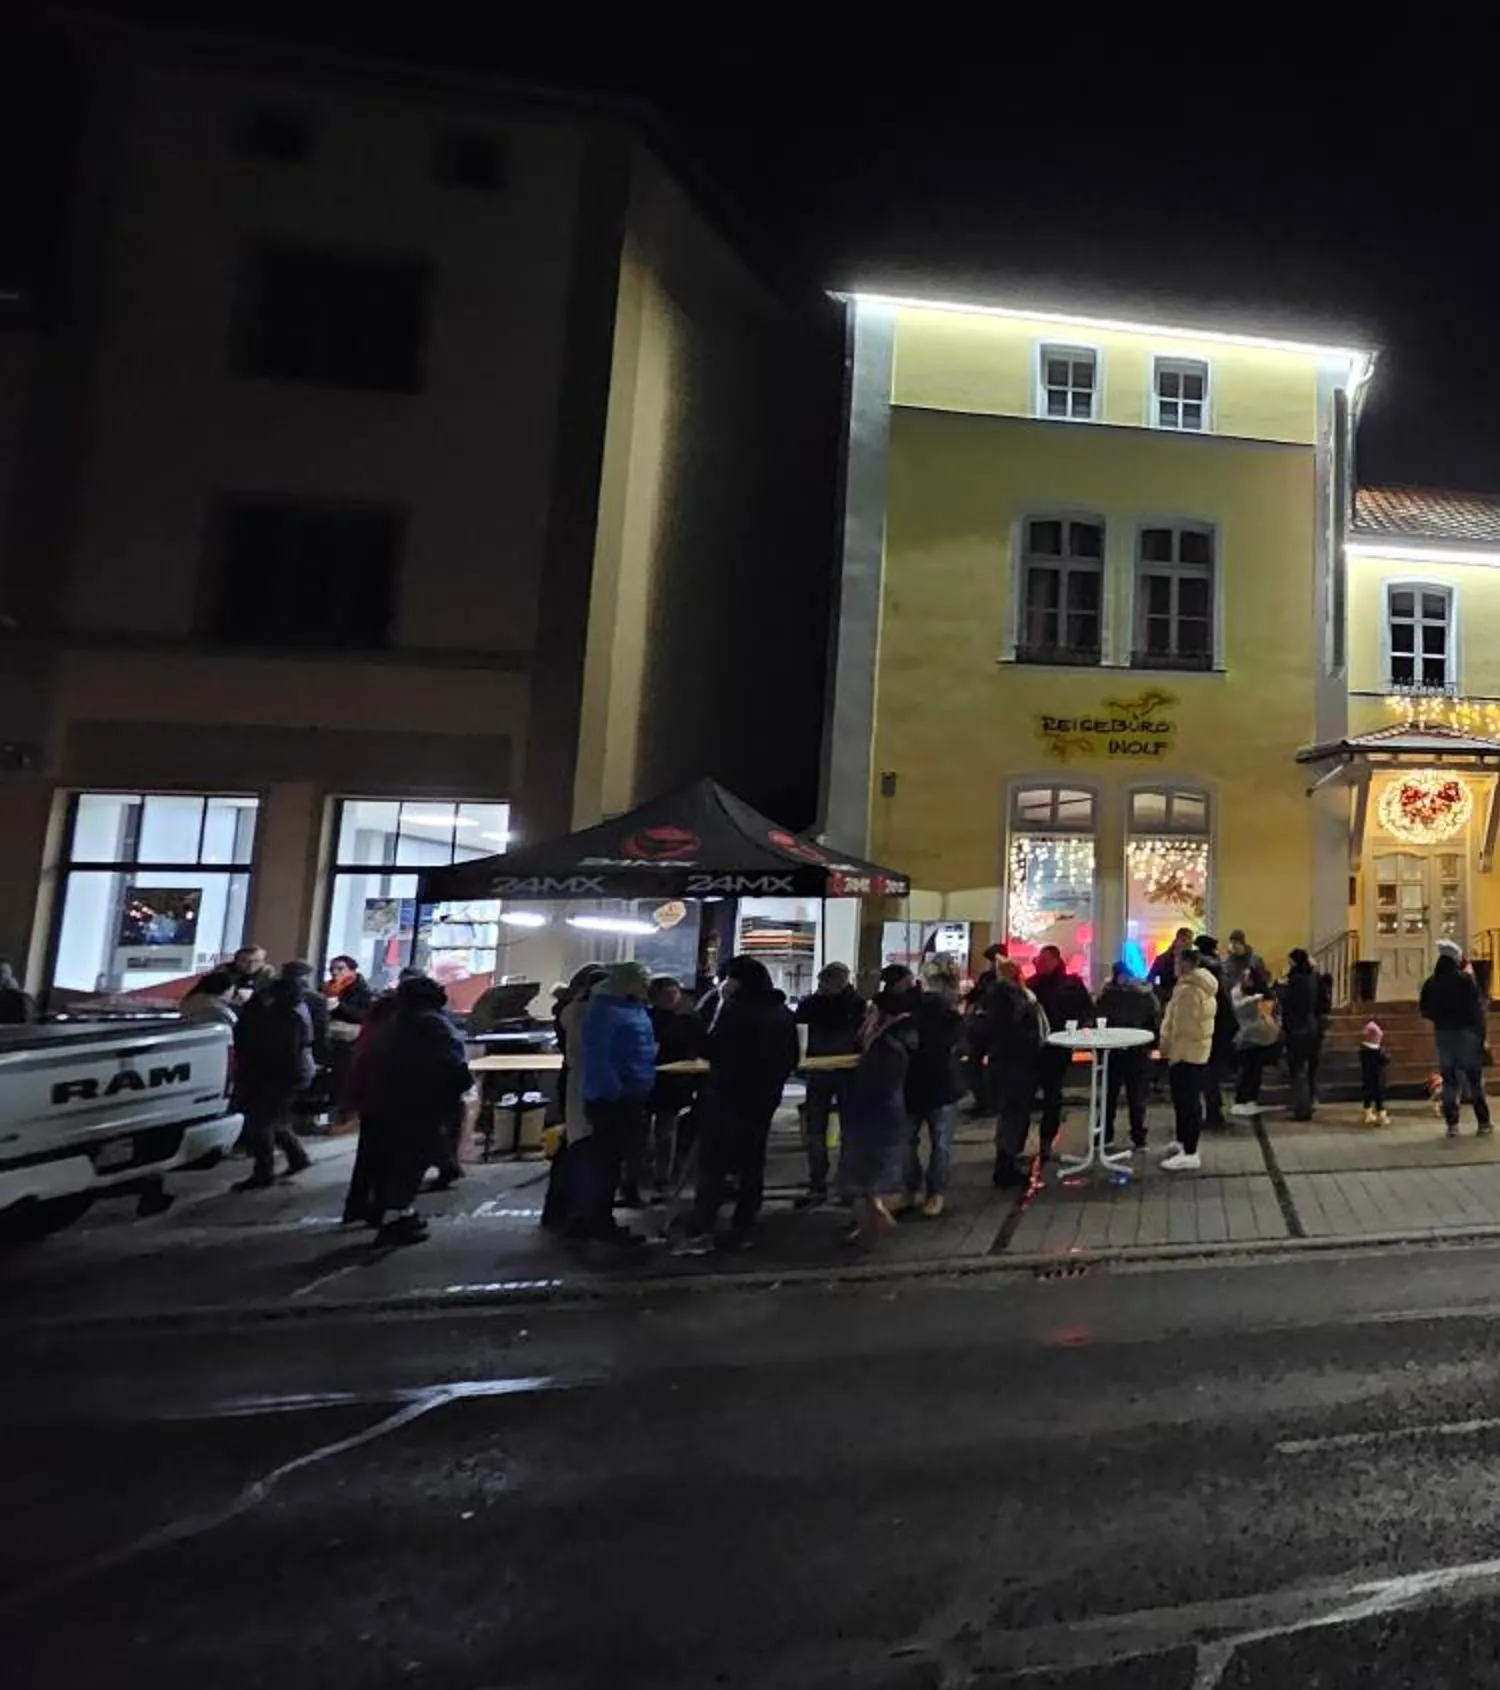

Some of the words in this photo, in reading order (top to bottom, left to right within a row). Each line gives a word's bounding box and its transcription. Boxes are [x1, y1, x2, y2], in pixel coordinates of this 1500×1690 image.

[1109, 739, 1168, 755] WOLF
[491, 875, 606, 894] 24MX
[686, 875, 795, 893] 24MX
[51, 1062, 191, 1104] RAM
